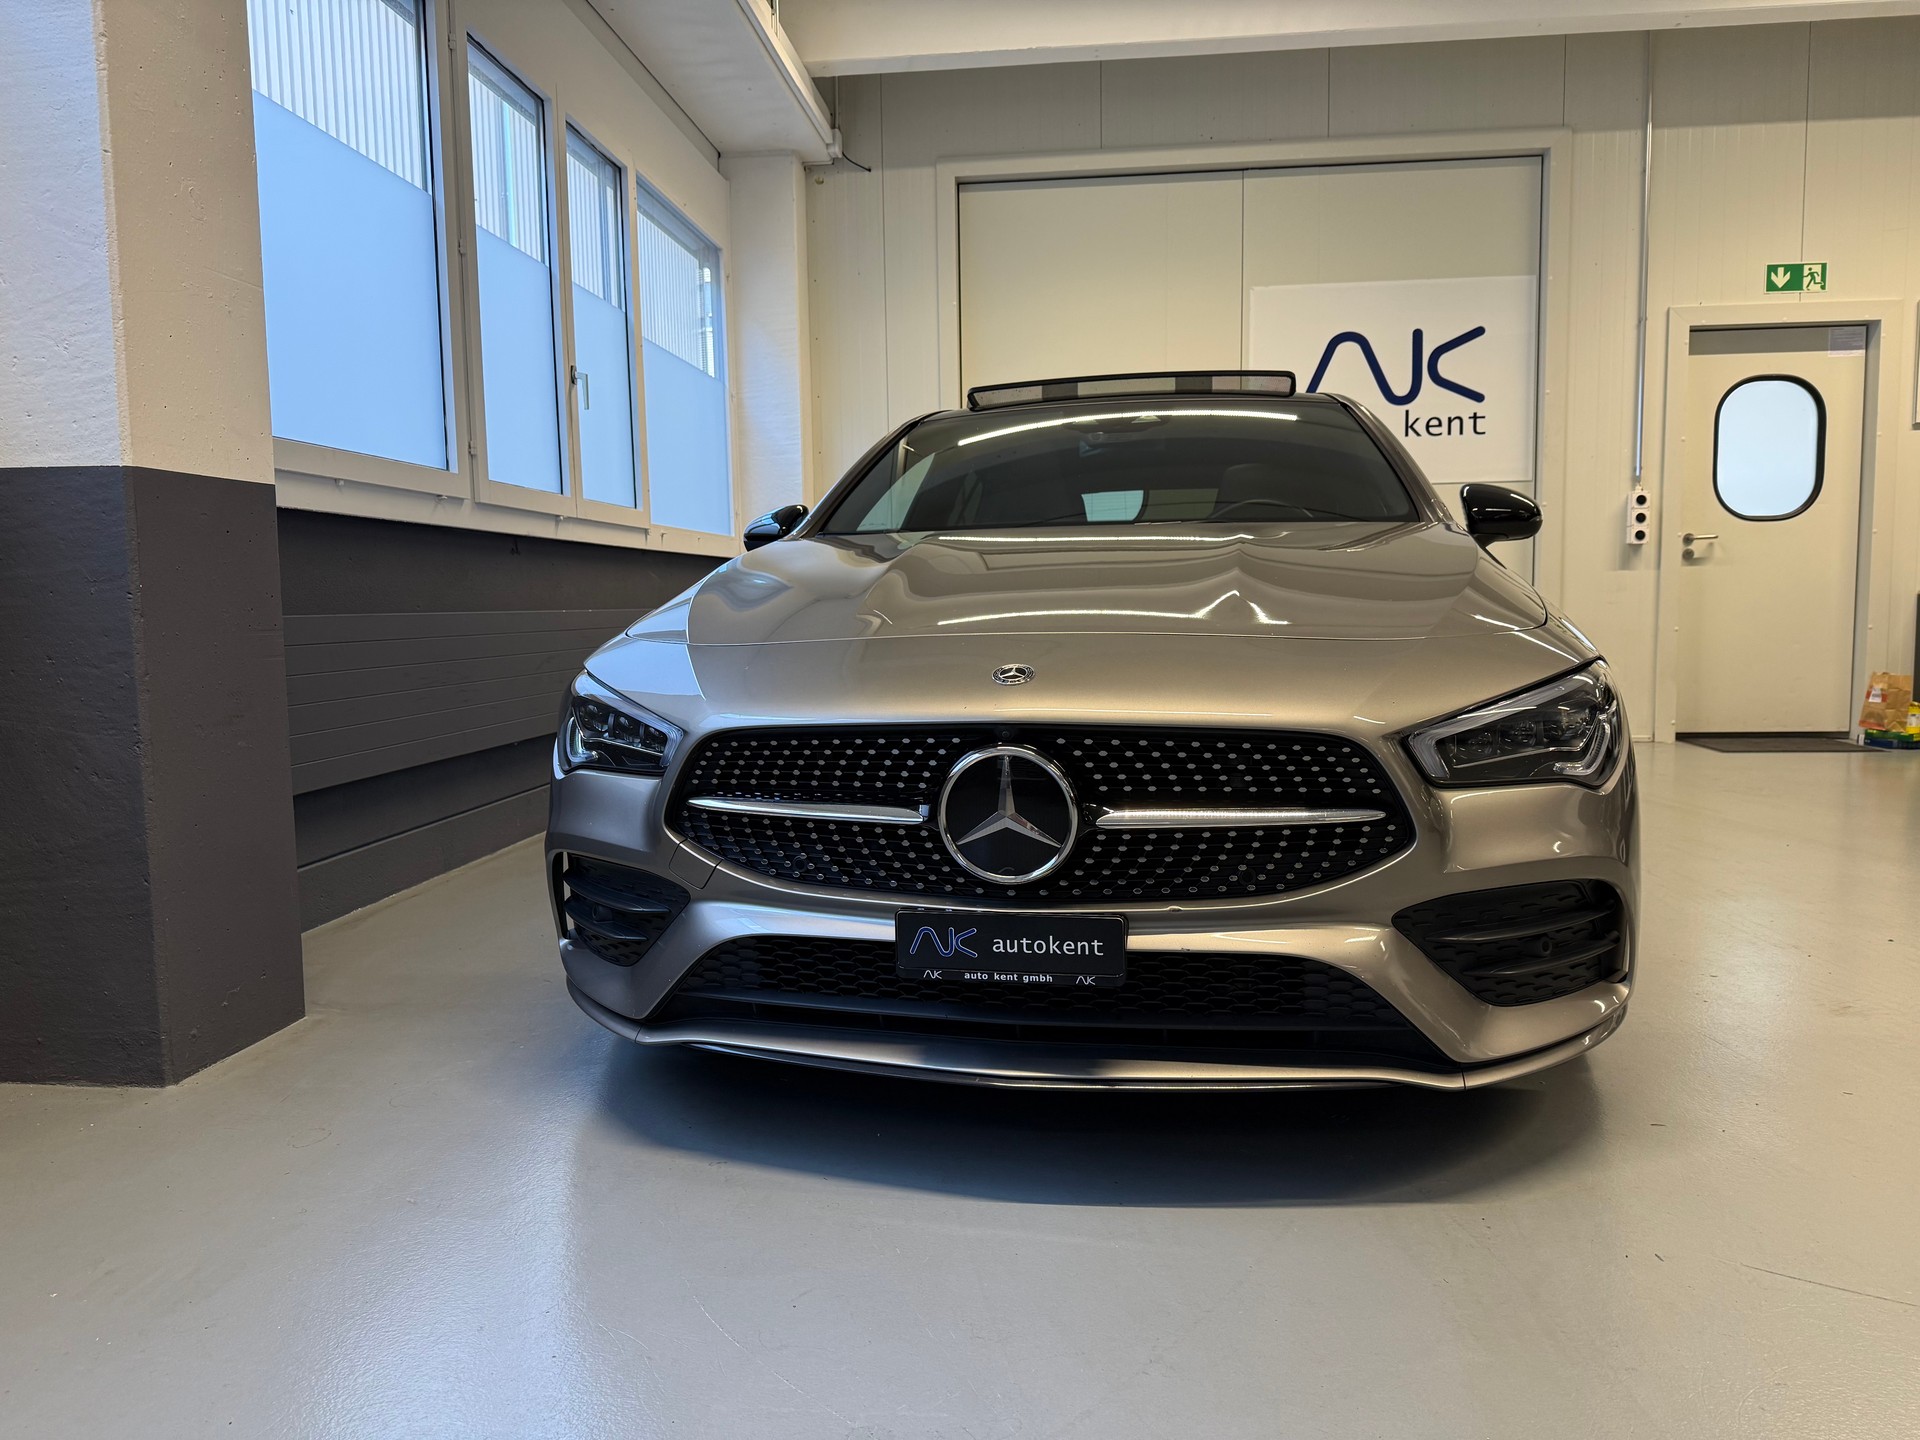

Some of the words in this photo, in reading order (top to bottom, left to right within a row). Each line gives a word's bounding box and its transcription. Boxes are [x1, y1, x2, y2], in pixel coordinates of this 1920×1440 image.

[1404, 410, 1487, 437] kent
[992, 935, 1104, 956] autokent
[964, 971, 988, 980] auto
[994, 972, 1018, 982] kent
[1022, 974, 1053, 983] gmbh
